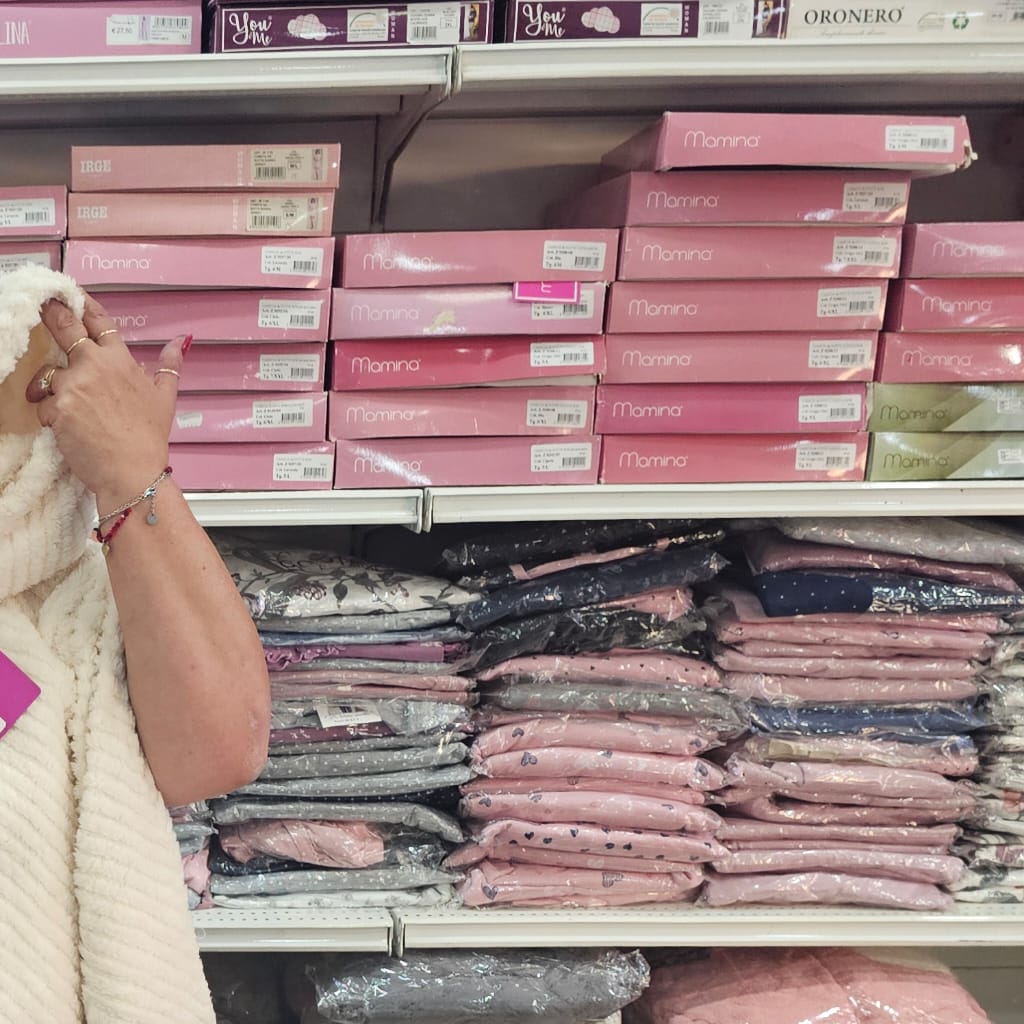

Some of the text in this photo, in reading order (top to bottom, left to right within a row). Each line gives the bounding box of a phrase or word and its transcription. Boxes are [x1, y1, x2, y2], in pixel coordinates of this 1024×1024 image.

[522, 3, 566, 37] You
[804, 8, 902, 25] ORONERO
[229, 12, 273, 44] You
[684, 131, 760, 148] Mamina
[80, 160, 112, 173] IRGE
[647, 190, 718, 208] Mamina
[76, 206, 108, 219] IRGE
[642, 244, 713, 262] Mamina
[81, 254, 150, 270] Mamina
[350, 304, 419, 321] Mamina
[628, 299, 698, 316] Mamina
[922, 295, 992, 313] Mamina
[351, 356, 420, 373] Mamina
[622, 350, 691, 367] Mamina
[901, 350, 972, 367] Mamina
[346, 406, 414, 424] Mamina
[612, 401, 682, 418] Mamina
[618, 451, 687, 468] Mamina
